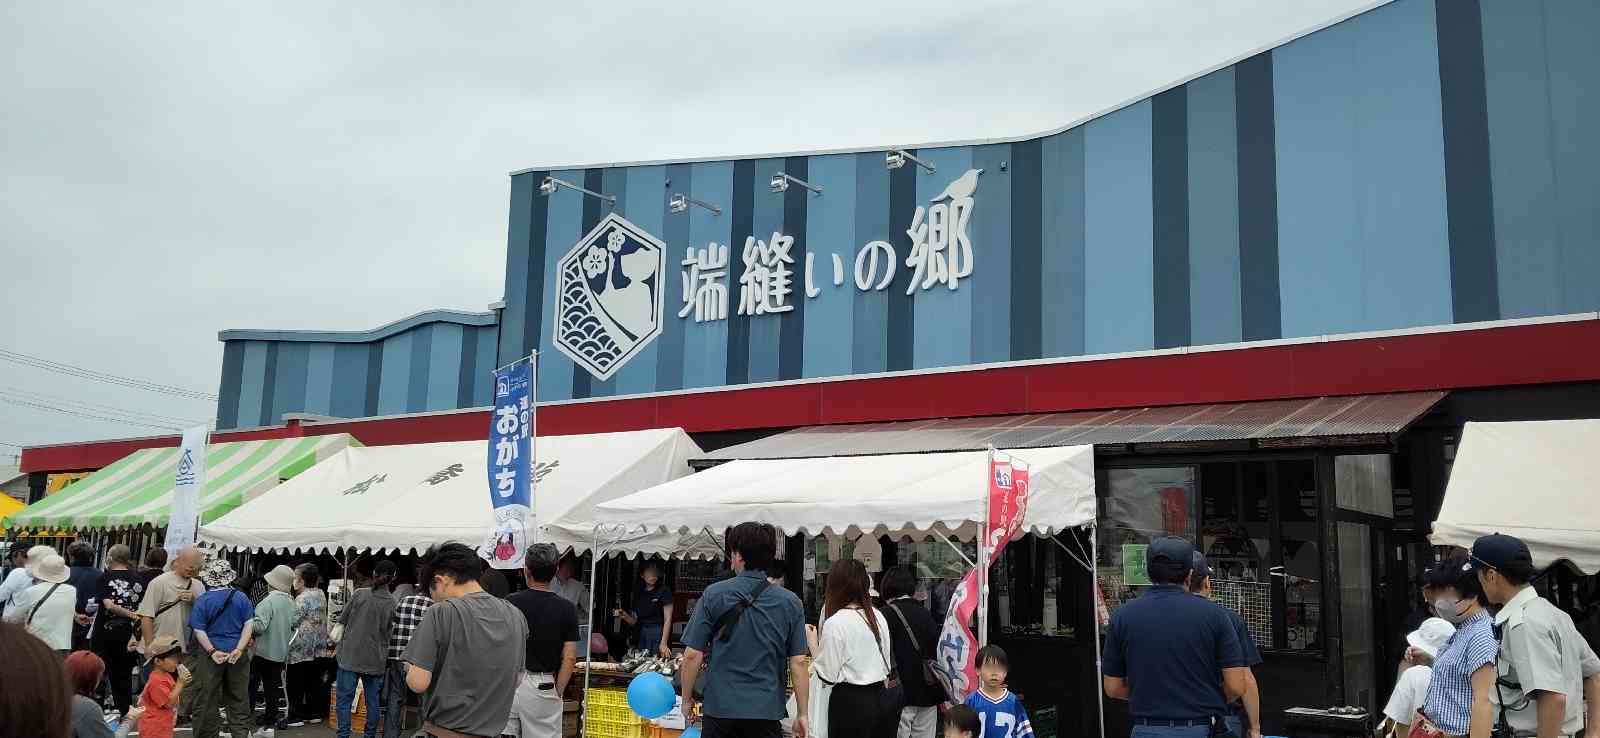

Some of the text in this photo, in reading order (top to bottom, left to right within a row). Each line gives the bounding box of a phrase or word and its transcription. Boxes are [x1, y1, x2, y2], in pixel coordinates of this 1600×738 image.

[678, 196, 976, 323] 端縫いの郷
[495, 404, 520, 498] おがち
